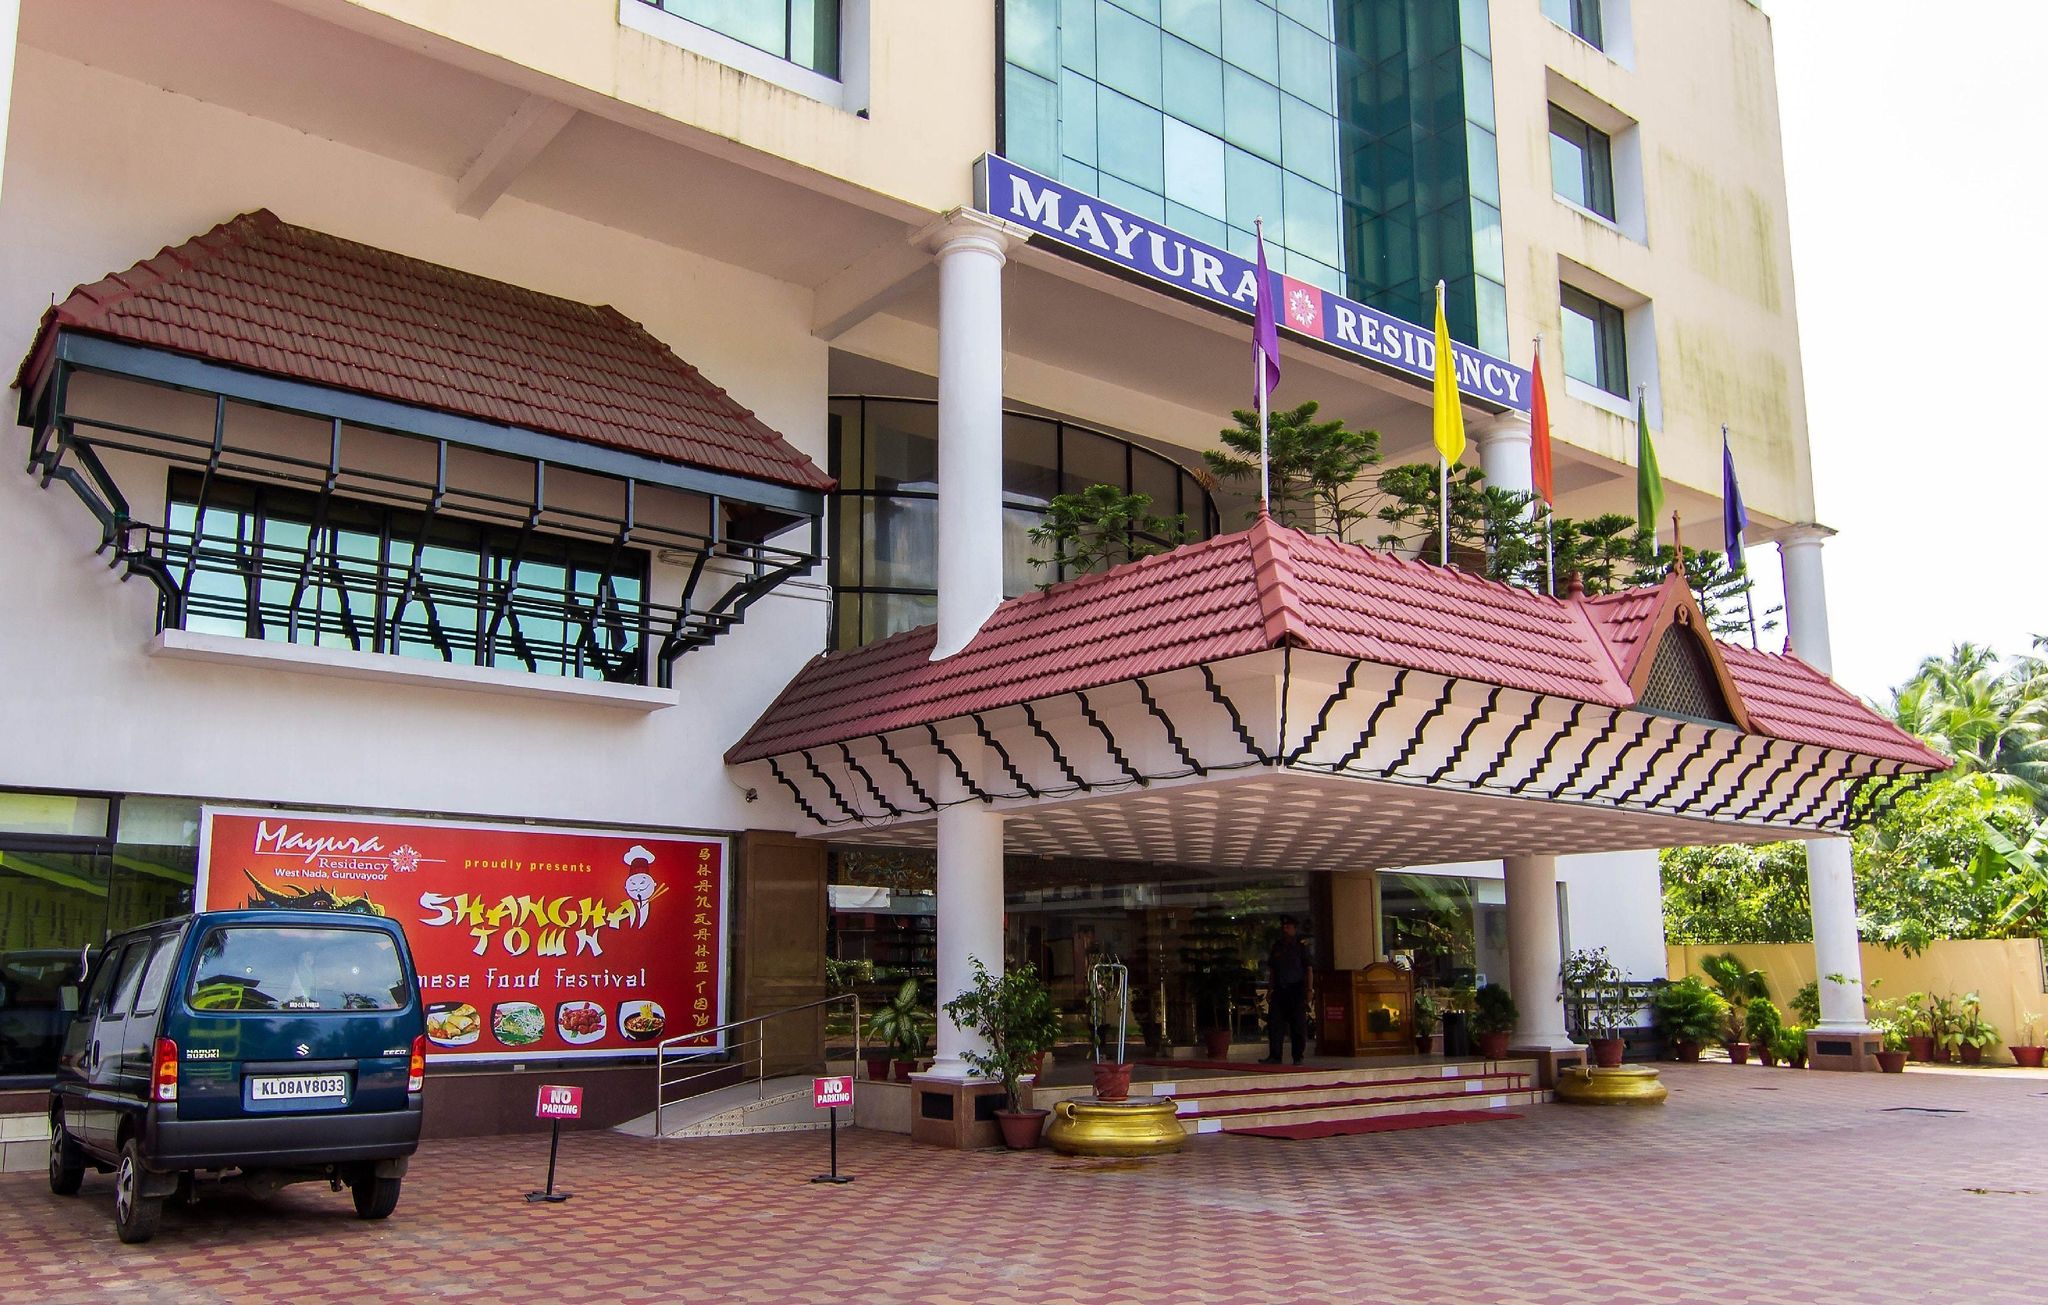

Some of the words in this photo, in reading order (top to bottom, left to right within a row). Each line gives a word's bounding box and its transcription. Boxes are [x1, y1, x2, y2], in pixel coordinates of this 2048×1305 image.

[1009, 174, 1258, 307] MAYURA
[255, 820, 384, 864] Mayura
[318, 857, 389, 873] Residency
[465, 859, 522, 871] proudly
[530, 861, 592, 873] presents
[275, 868, 299, 877] West
[302, 870, 329, 880] Nada,
[332, 871, 388, 881] Guruvayoor
[469, 927, 603, 957] TOWN
[823, 1080, 842, 1093] NO
[550, 1089, 572, 1104] NO
[817, 1092, 849, 1104] PARKING
[542, 1103, 578, 1115] PARKING
